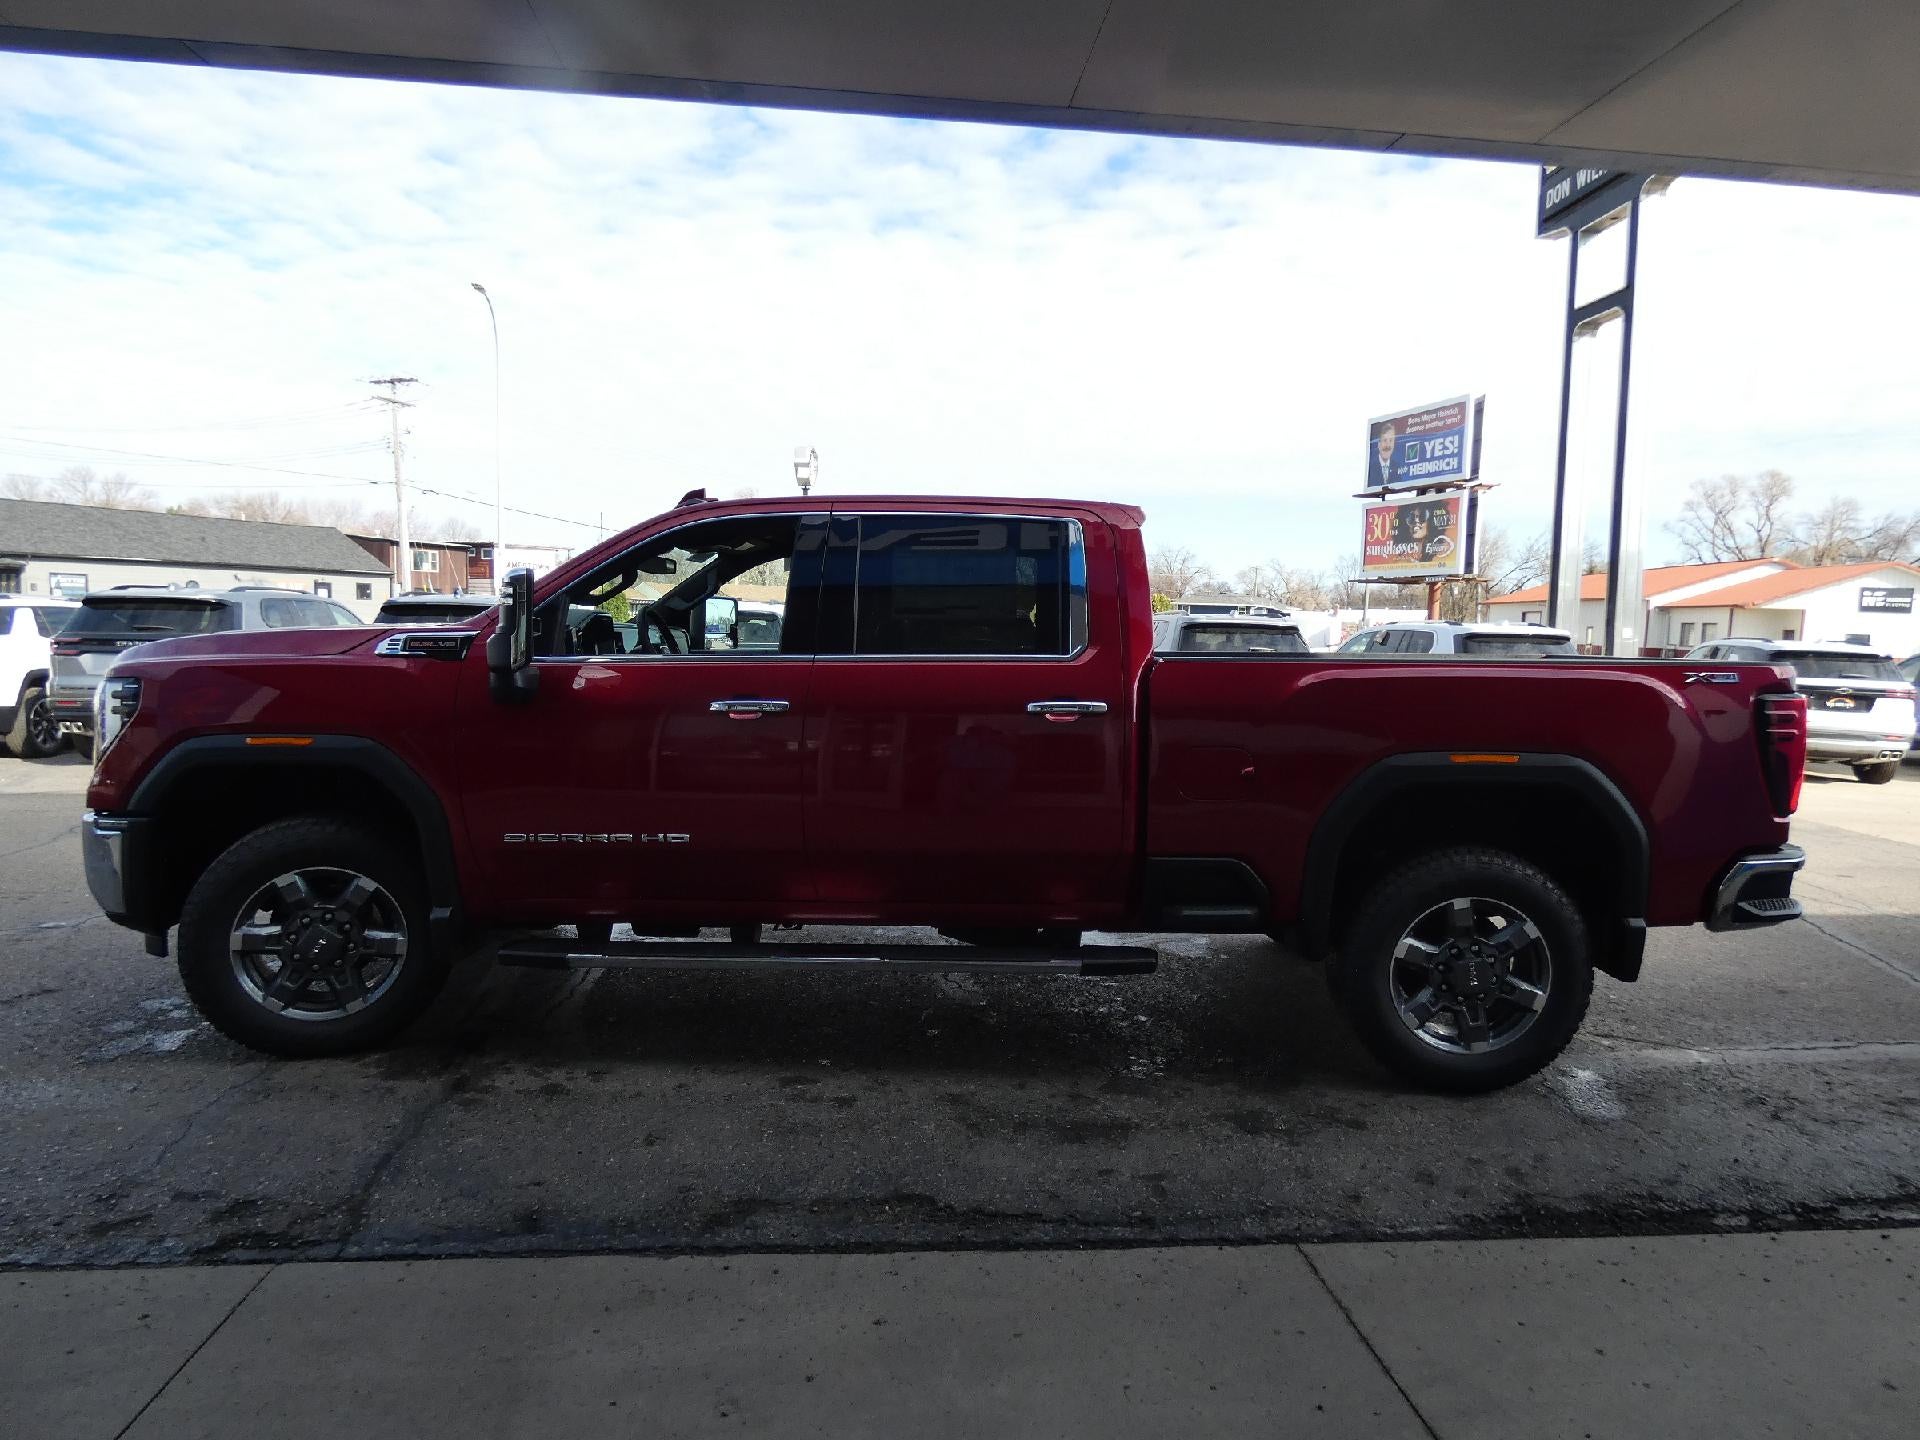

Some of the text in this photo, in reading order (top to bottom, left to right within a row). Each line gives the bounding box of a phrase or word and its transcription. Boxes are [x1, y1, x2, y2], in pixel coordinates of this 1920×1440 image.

[1545, 169, 1607, 209] DON WIL
[1424, 435, 1459, 459] YES!
[1409, 457, 1458, 476] HEINRICH
[503, 833, 690, 843] SIERRA HD
